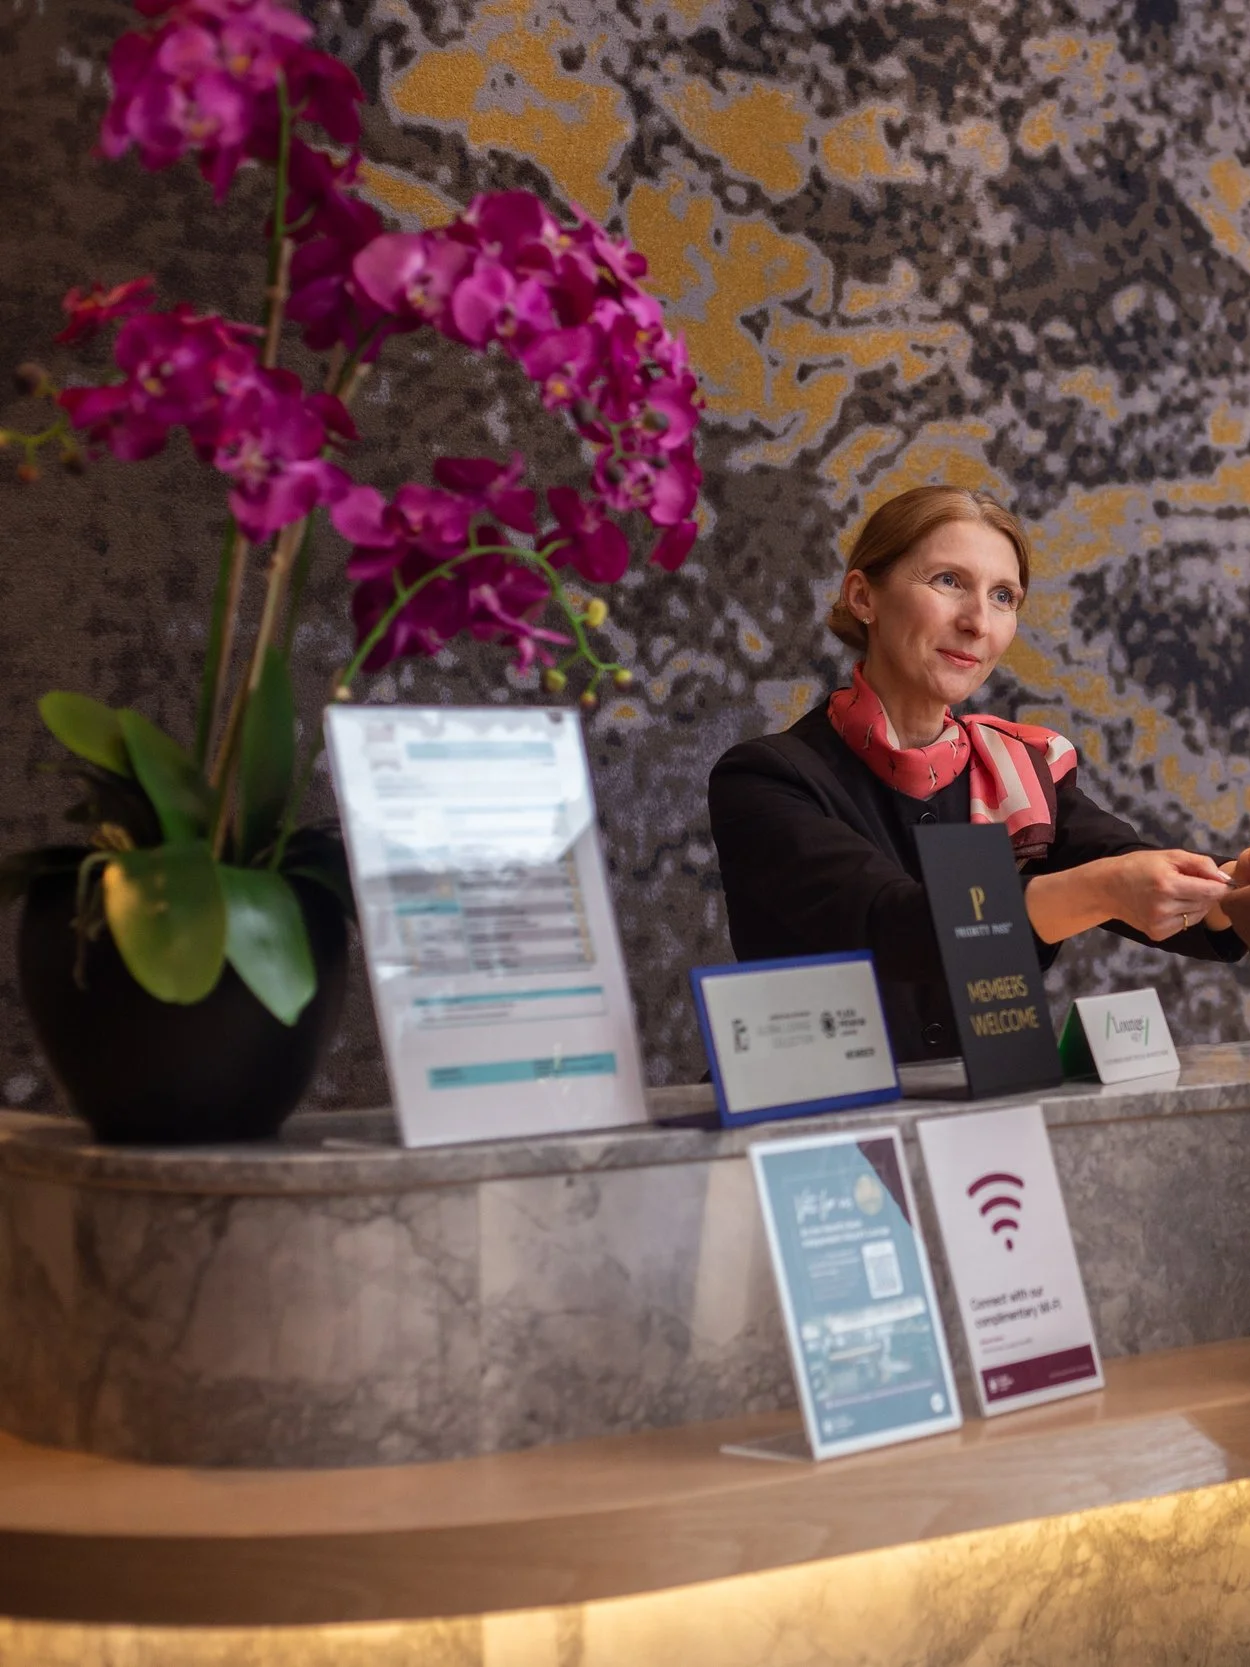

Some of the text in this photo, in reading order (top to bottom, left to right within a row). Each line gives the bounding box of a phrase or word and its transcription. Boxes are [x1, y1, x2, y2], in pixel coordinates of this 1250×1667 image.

[968, 885, 985, 921] P
[966, 975, 1028, 1003] MEMBERS
[970, 1006, 1039, 1036] WELCOME
[969, 1285, 1044, 1312] Connect with our
[974, 1306, 1038, 1330] complimentary
